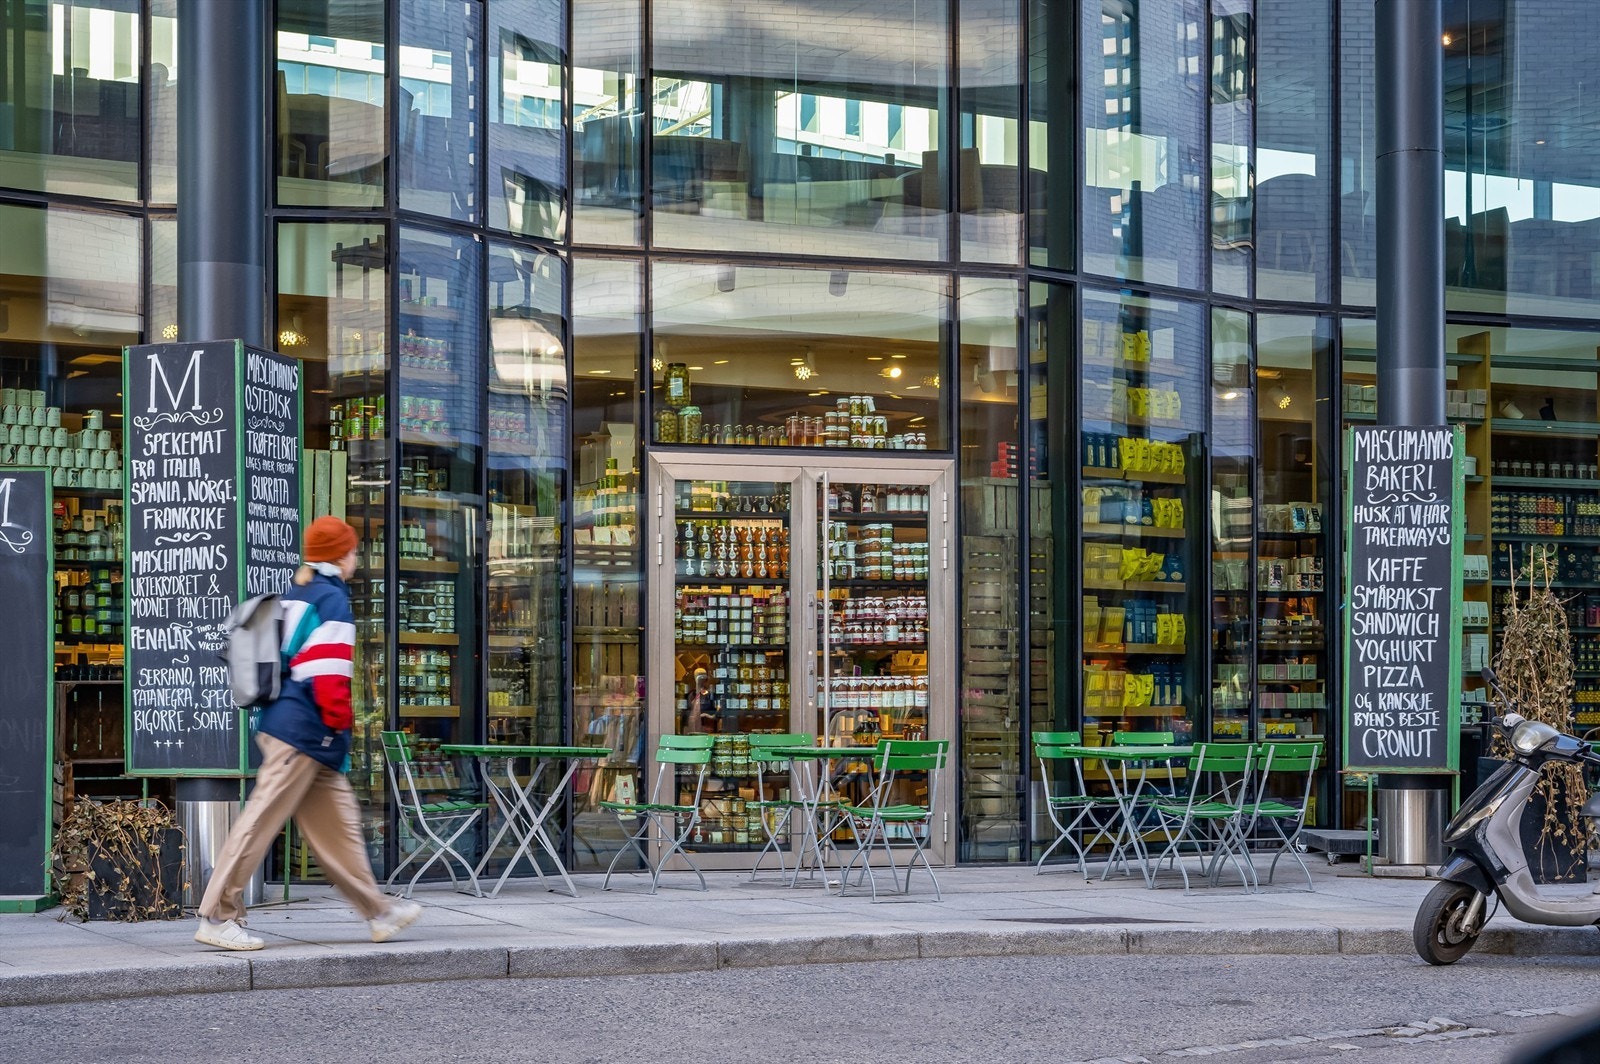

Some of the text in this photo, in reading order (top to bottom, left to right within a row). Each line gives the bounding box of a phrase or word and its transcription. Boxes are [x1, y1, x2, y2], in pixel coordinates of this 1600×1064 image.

[147, 350, 205, 413] M
[246, 353, 298, 392] MASCHMANNS
[245, 384, 292, 420] OSTEDISK
[143, 429, 227, 456] SPEKEMAT
[245, 430, 298, 462] TRØFFELBRIE
[1354, 430, 1454, 463] MASCHMANNS
[131, 459, 156, 480] FRA
[245, 456, 262, 472] LAGES
[276, 461, 295, 475] FREDAG
[1366, 463, 1434, 492] BAKERI
[251, 475, 290, 505] BURRATA
[143, 507, 227, 530] FRANKRIKE
[247, 501, 299, 523] KOMMER HVER MANDAG
[1353, 504, 1451, 527] HUSK AT VI HAR
[246, 519, 293, 553] MANCHEGO
[1362, 526, 1438, 547] TAKEAWAY
[131, 544, 227, 573] MASCHMANNS
[1367, 557, 1428, 583] KAFFE
[131, 573, 220, 597] URTEKRYDRET &
[246, 564, 294, 595] KRAFTKAR
[131, 595, 232, 619] MODNET PANCETTA
[1352, 584, 1443, 611] SMÅBAKST
[1351, 611, 1440, 637] SANDWICH
[1355, 638, 1438, 664] YOGHURT
[138, 666, 196, 690] SERRANO,
[1364, 665, 1425, 689] PIZZA
[132, 688, 199, 709] PATANEGRA,
[1354, 692, 1434, 711] OG KANSKJE
[134, 711, 192, 733] BIGORRE,
[192, 711, 233, 731] SOAVE
[1353, 711, 1441, 727] BYENS BESTE
[1362, 727, 1438, 759] CRONUT
